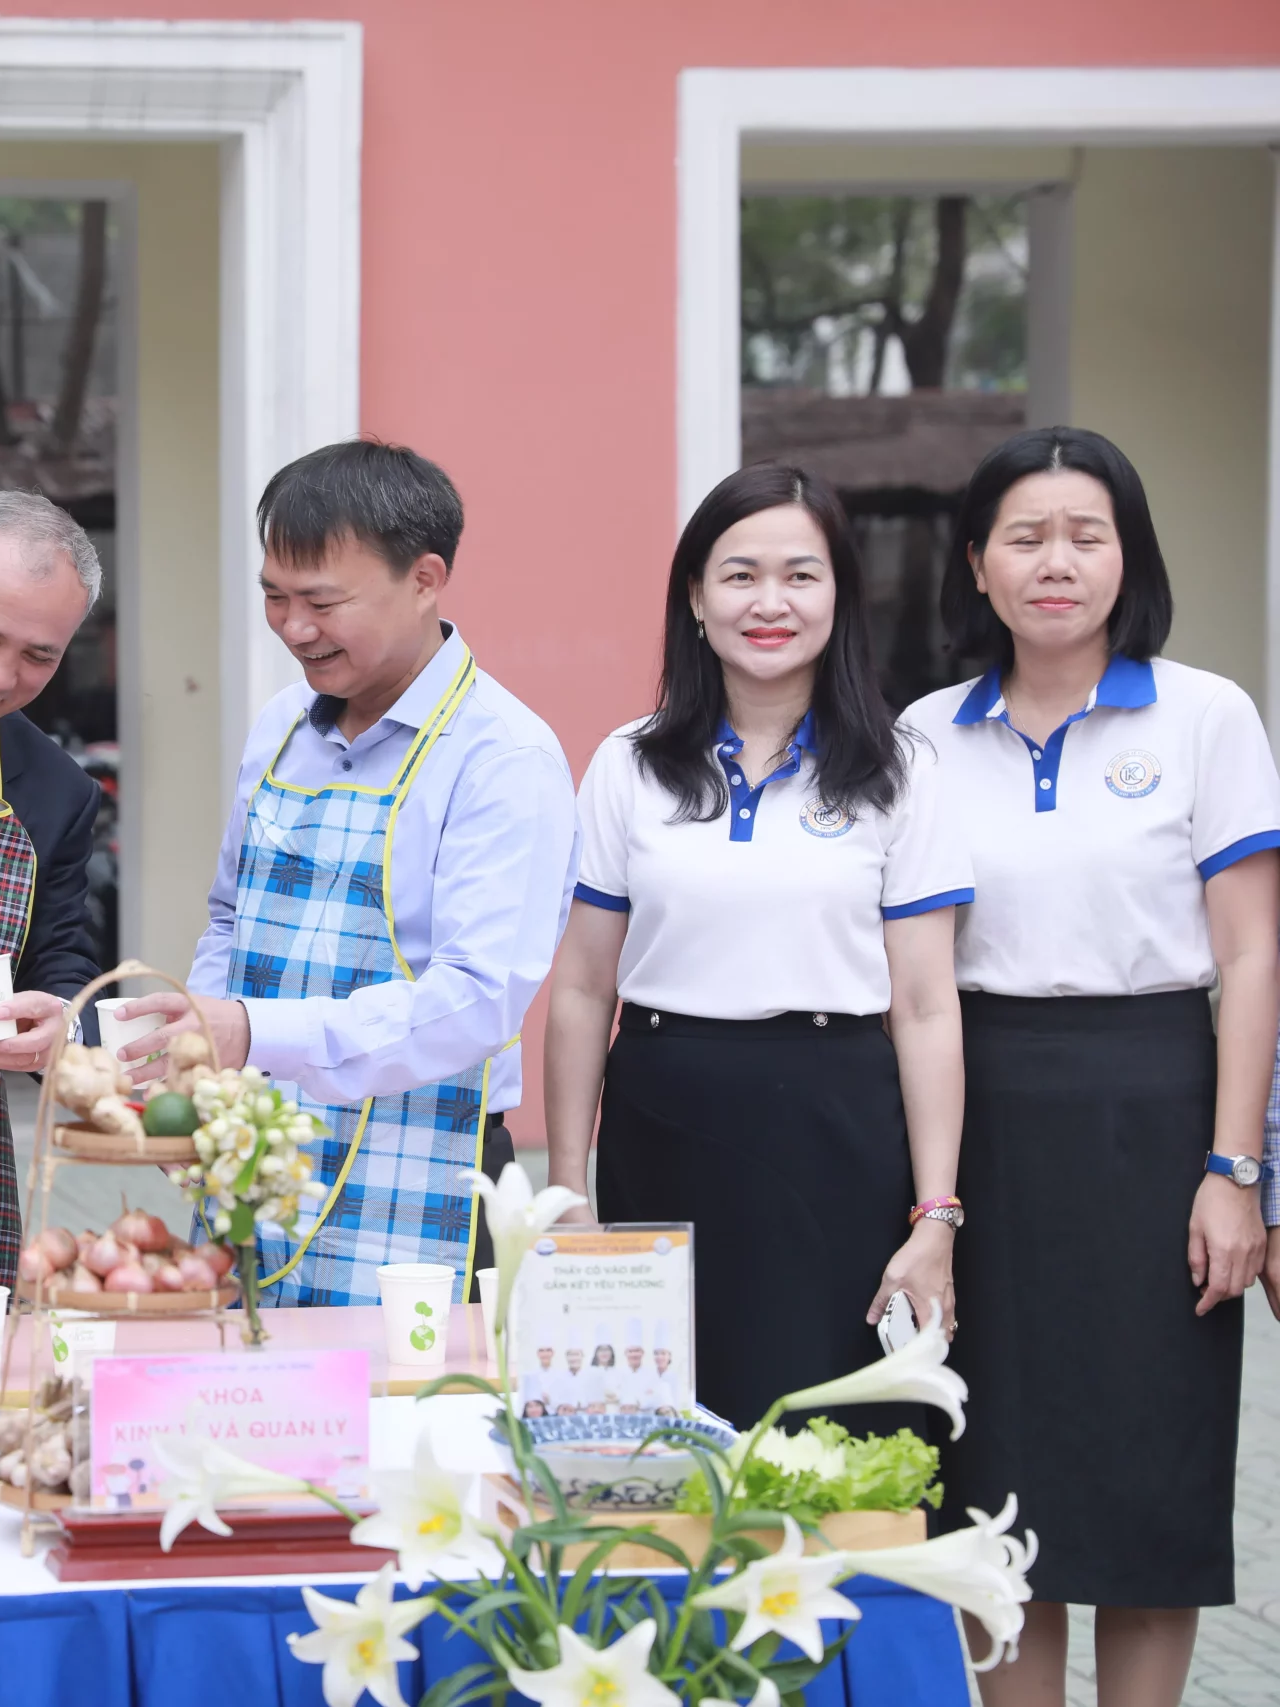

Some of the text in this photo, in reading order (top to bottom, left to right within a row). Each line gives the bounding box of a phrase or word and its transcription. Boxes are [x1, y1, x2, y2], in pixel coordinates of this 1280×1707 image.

[585, 1264, 601, 1275] CÔ
[603, 1264, 628, 1275] VÀO
[594, 1279, 615, 1289] YÊU
[198, 1387, 264, 1405] KHOA
